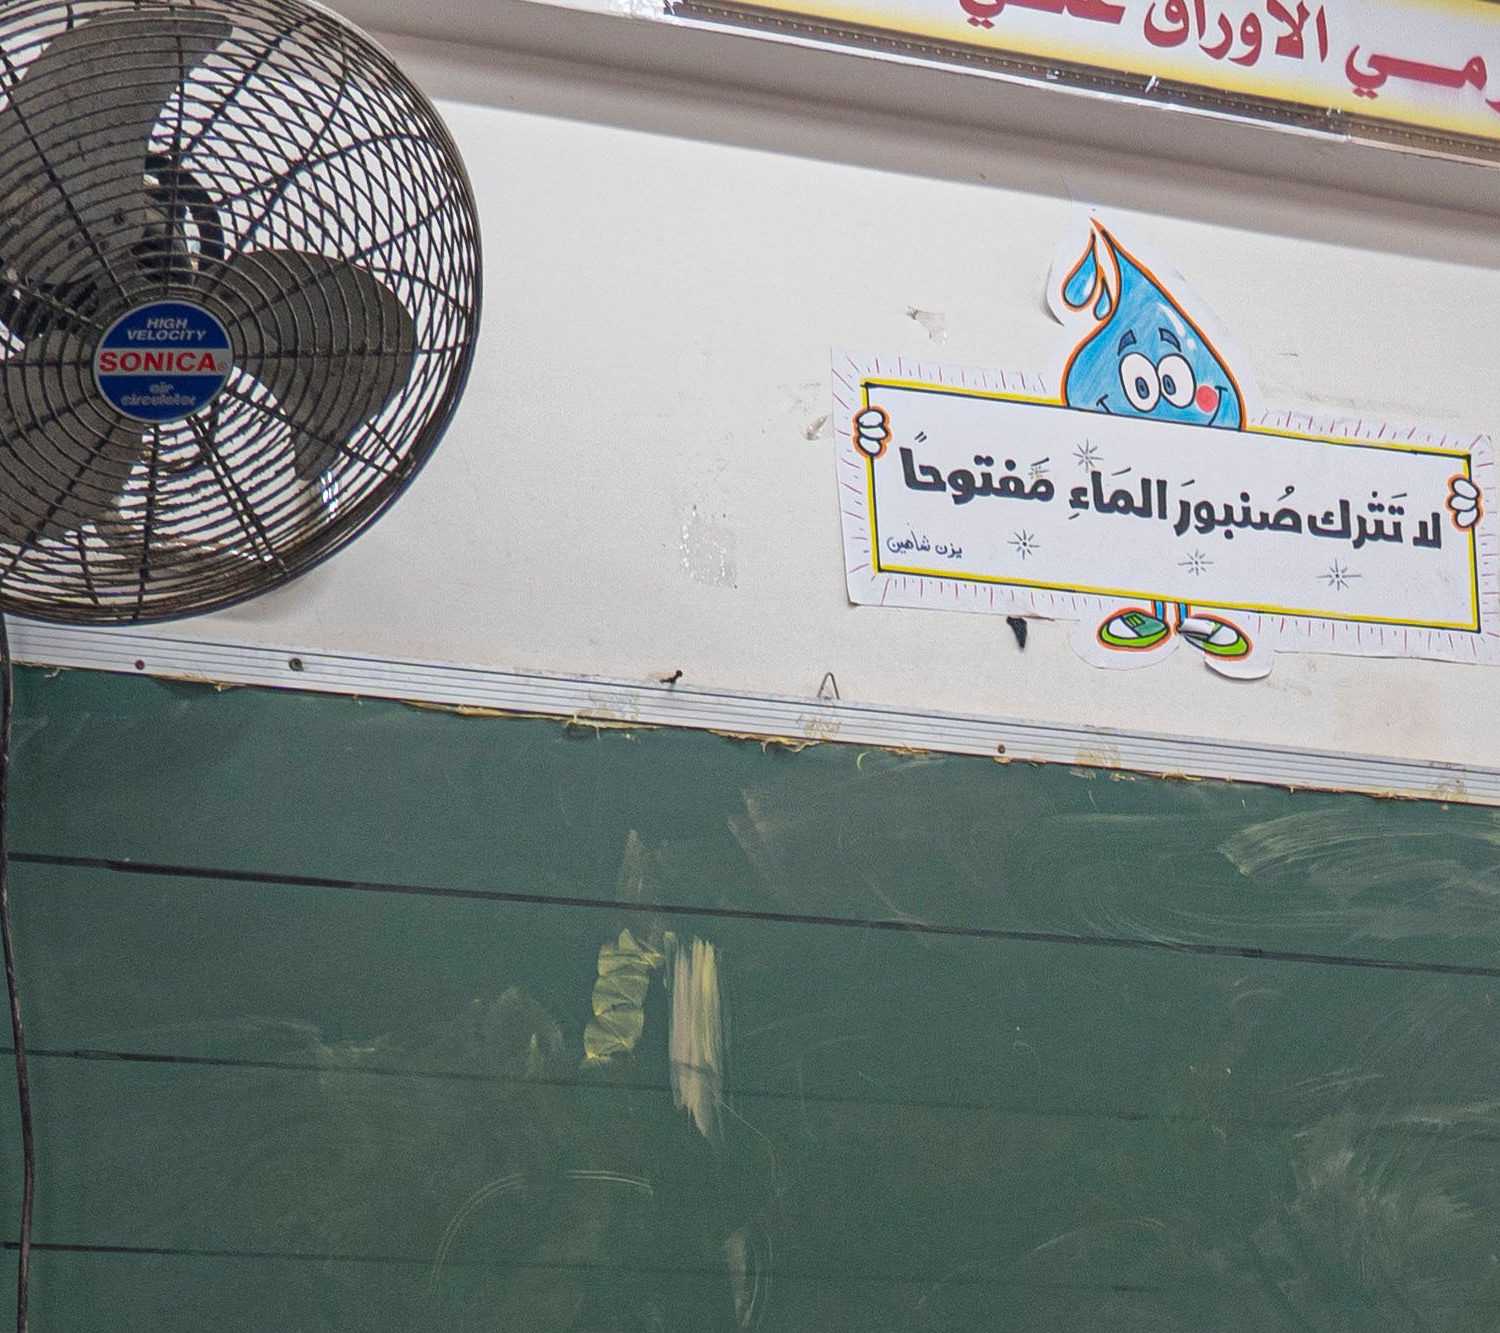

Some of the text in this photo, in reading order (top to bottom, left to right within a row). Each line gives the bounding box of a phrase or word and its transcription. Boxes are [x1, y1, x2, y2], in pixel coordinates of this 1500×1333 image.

[146, 317, 189, 329] HIGH
[127, 329, 208, 341] VELOCITY
[98, 350, 217, 372] SONICA
[1412, 511, 1442, 550] لا
